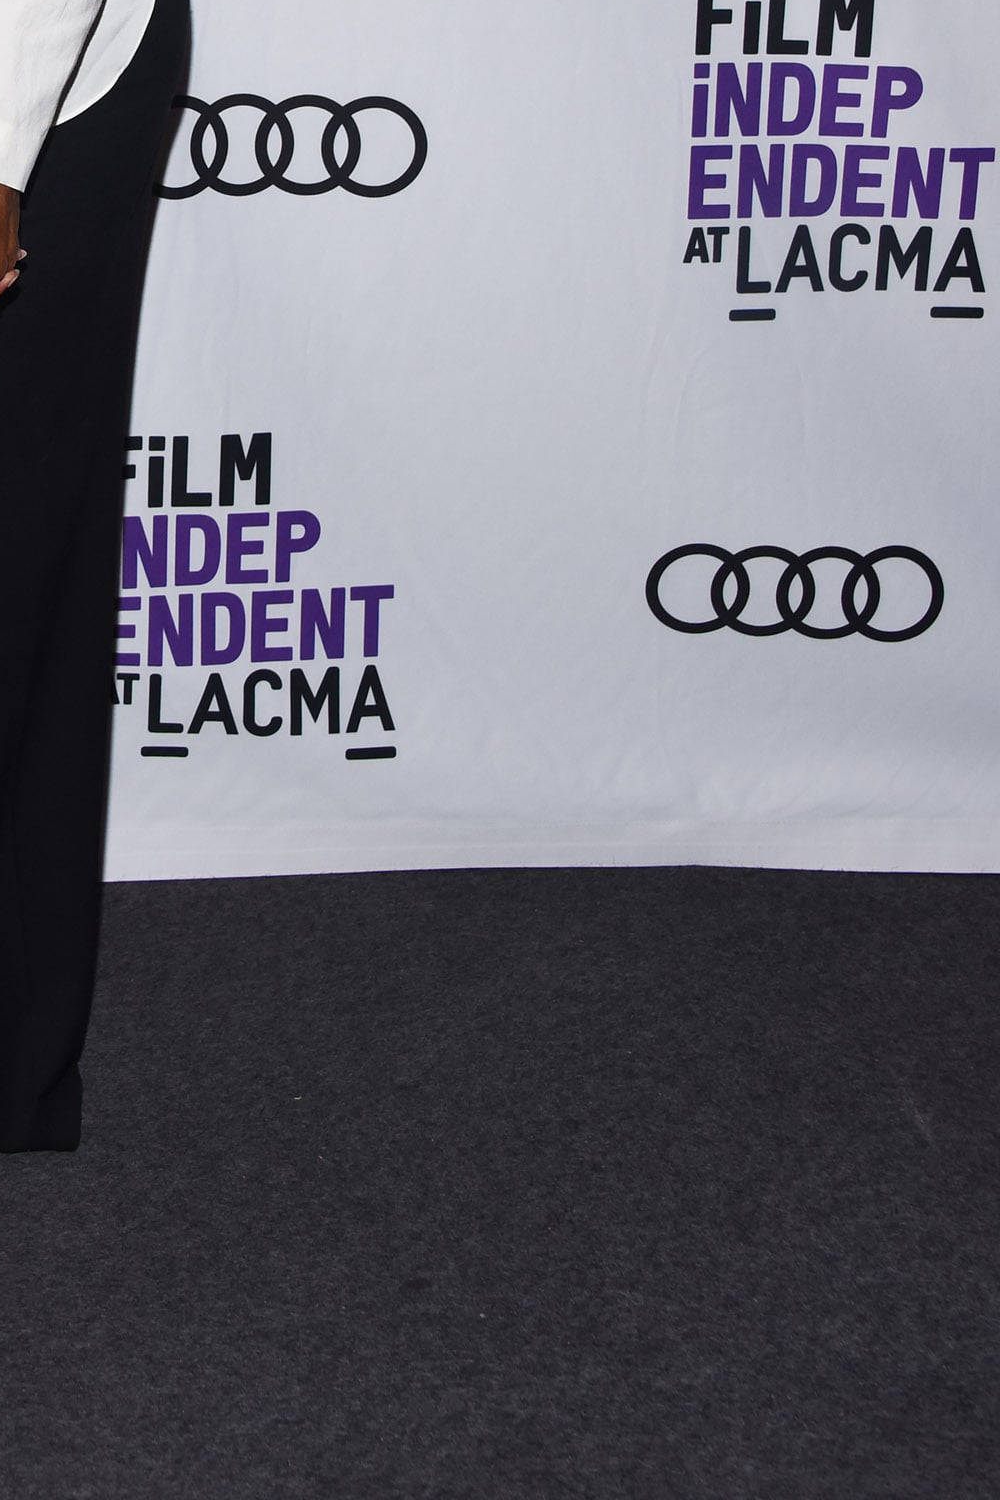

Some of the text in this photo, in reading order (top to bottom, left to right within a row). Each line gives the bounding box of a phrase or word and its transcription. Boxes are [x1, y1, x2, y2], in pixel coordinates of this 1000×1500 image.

[687, 144, 995, 220] ENDENT
[683, 223, 985, 294] AT LACMA
[148, 665, 395, 737] LACMA
